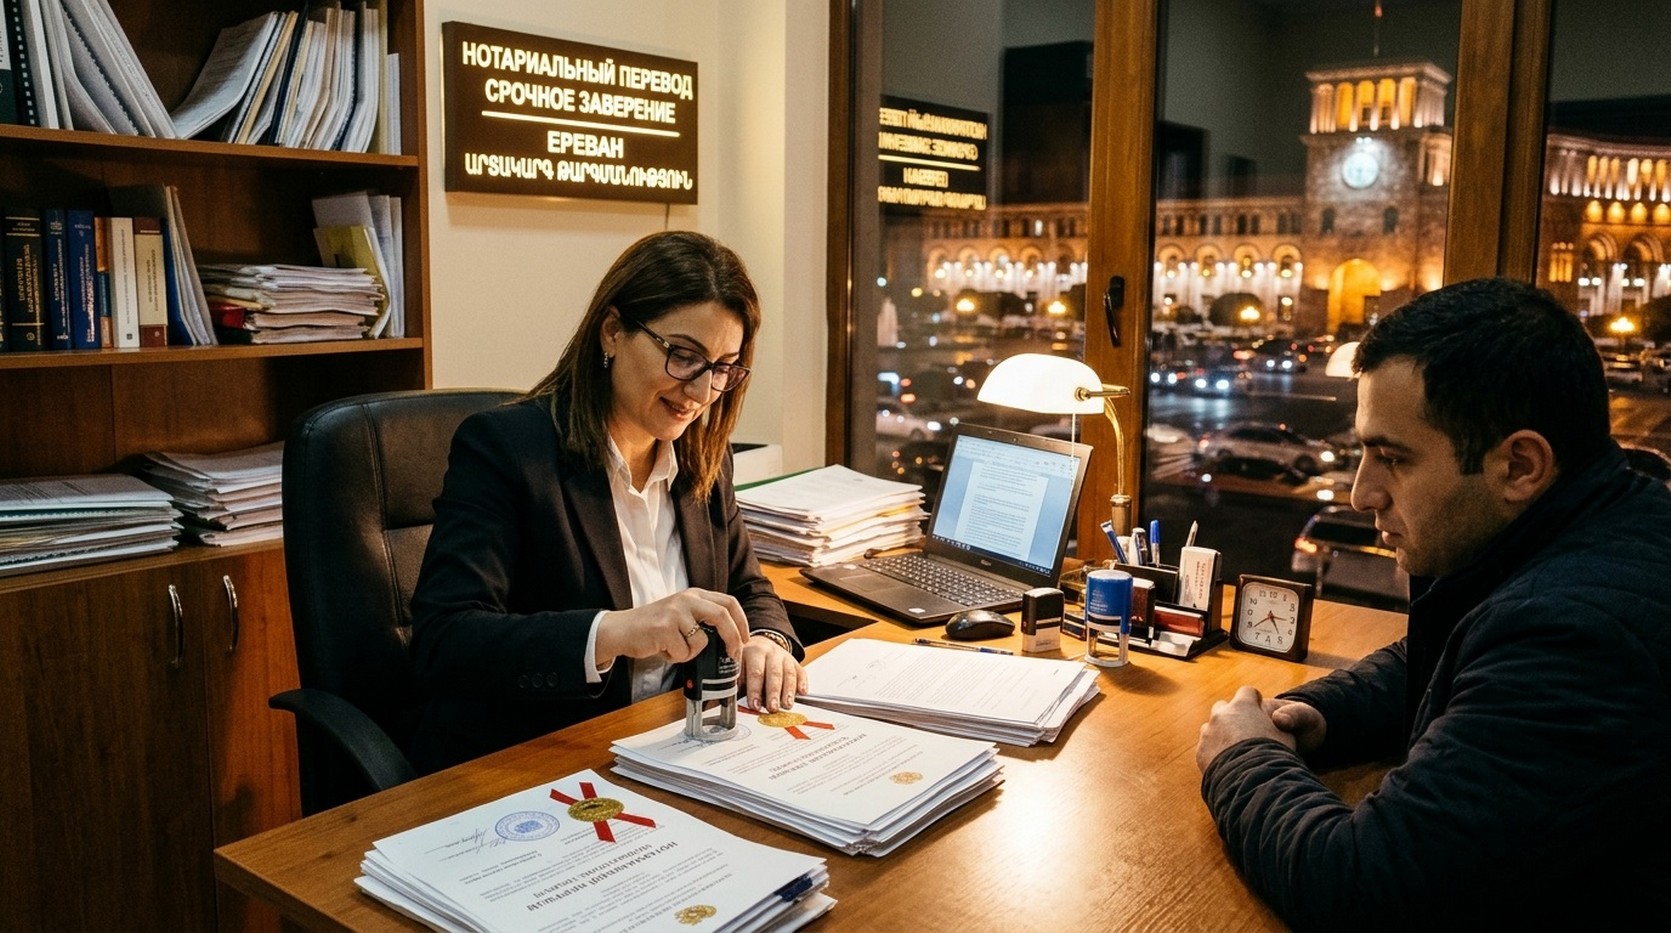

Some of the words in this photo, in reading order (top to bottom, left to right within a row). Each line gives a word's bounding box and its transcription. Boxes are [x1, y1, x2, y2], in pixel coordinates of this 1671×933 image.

[462, 41, 615, 85] НОТАРИАЛЬНЫЙ
[619, 65, 693, 100] ПЕРЕВОД
[485, 78, 576, 112] СРОЧНОЕ
[579, 90, 676, 124] ЗАВЕРЕНИЕ
[547, 130, 624, 158] ЕРЕВАН
[465, 153, 554, 180] ԱՐՏԱԿԱՐԳ
